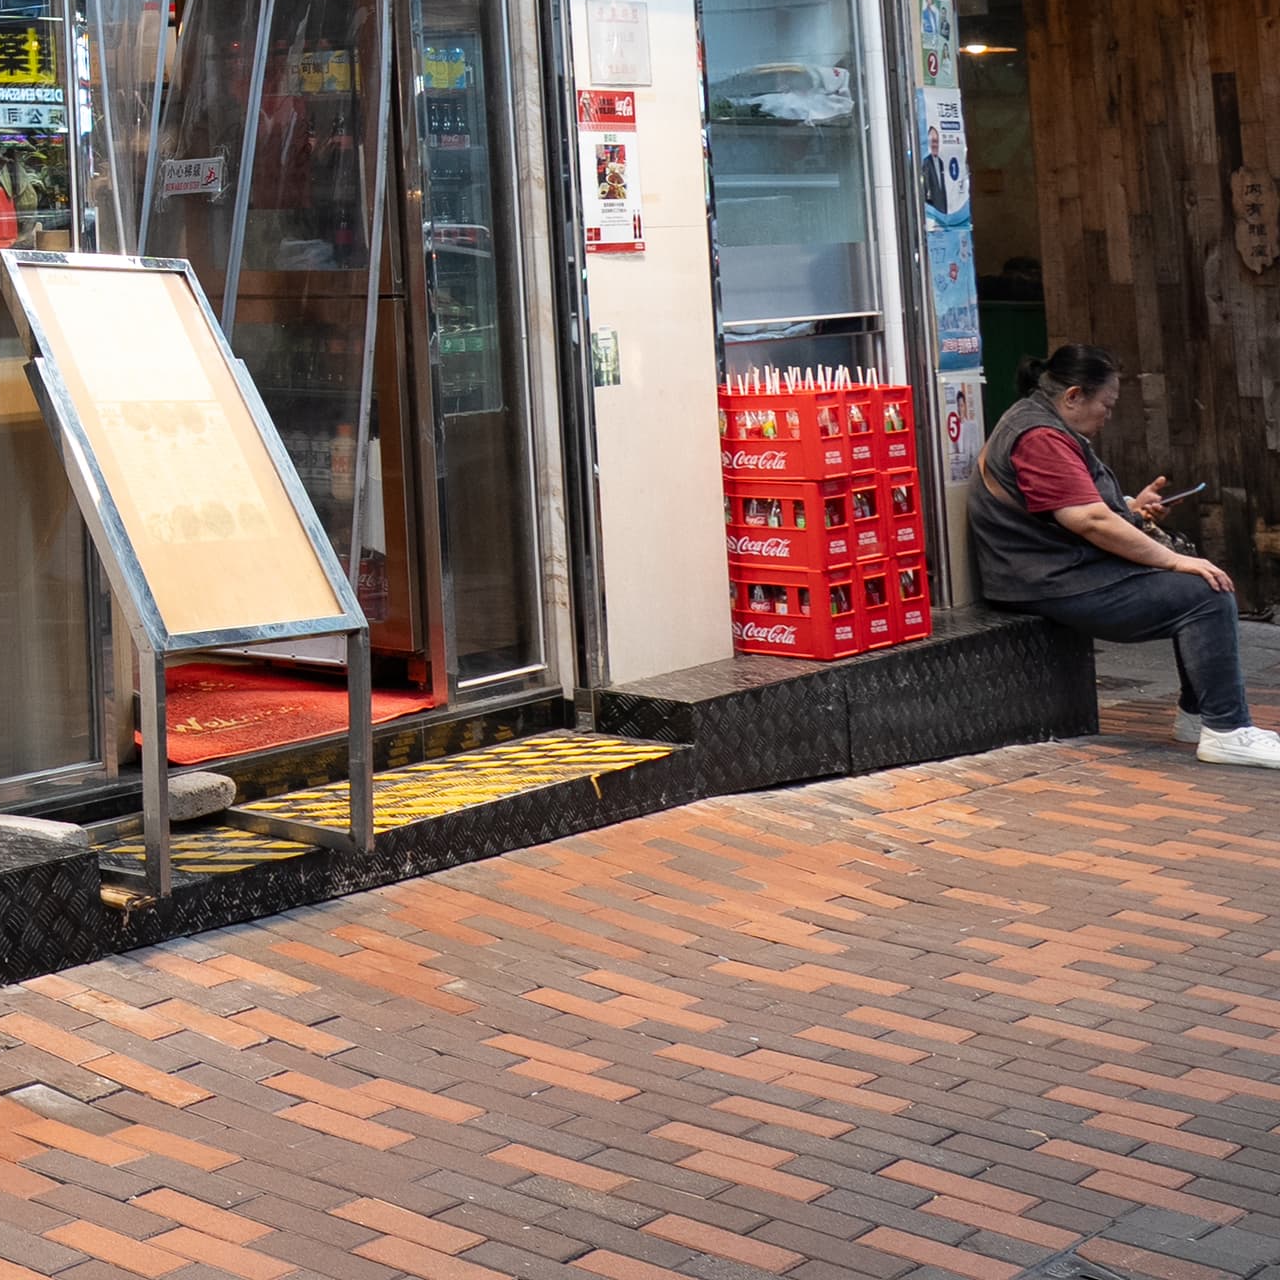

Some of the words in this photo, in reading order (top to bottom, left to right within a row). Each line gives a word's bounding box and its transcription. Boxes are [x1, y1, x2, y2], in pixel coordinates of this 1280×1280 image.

[733, 451, 786, 470] Coca-Cola
[738, 536, 791, 558] Coca-Cola
[743, 622, 796, 645] Coca-Cola
